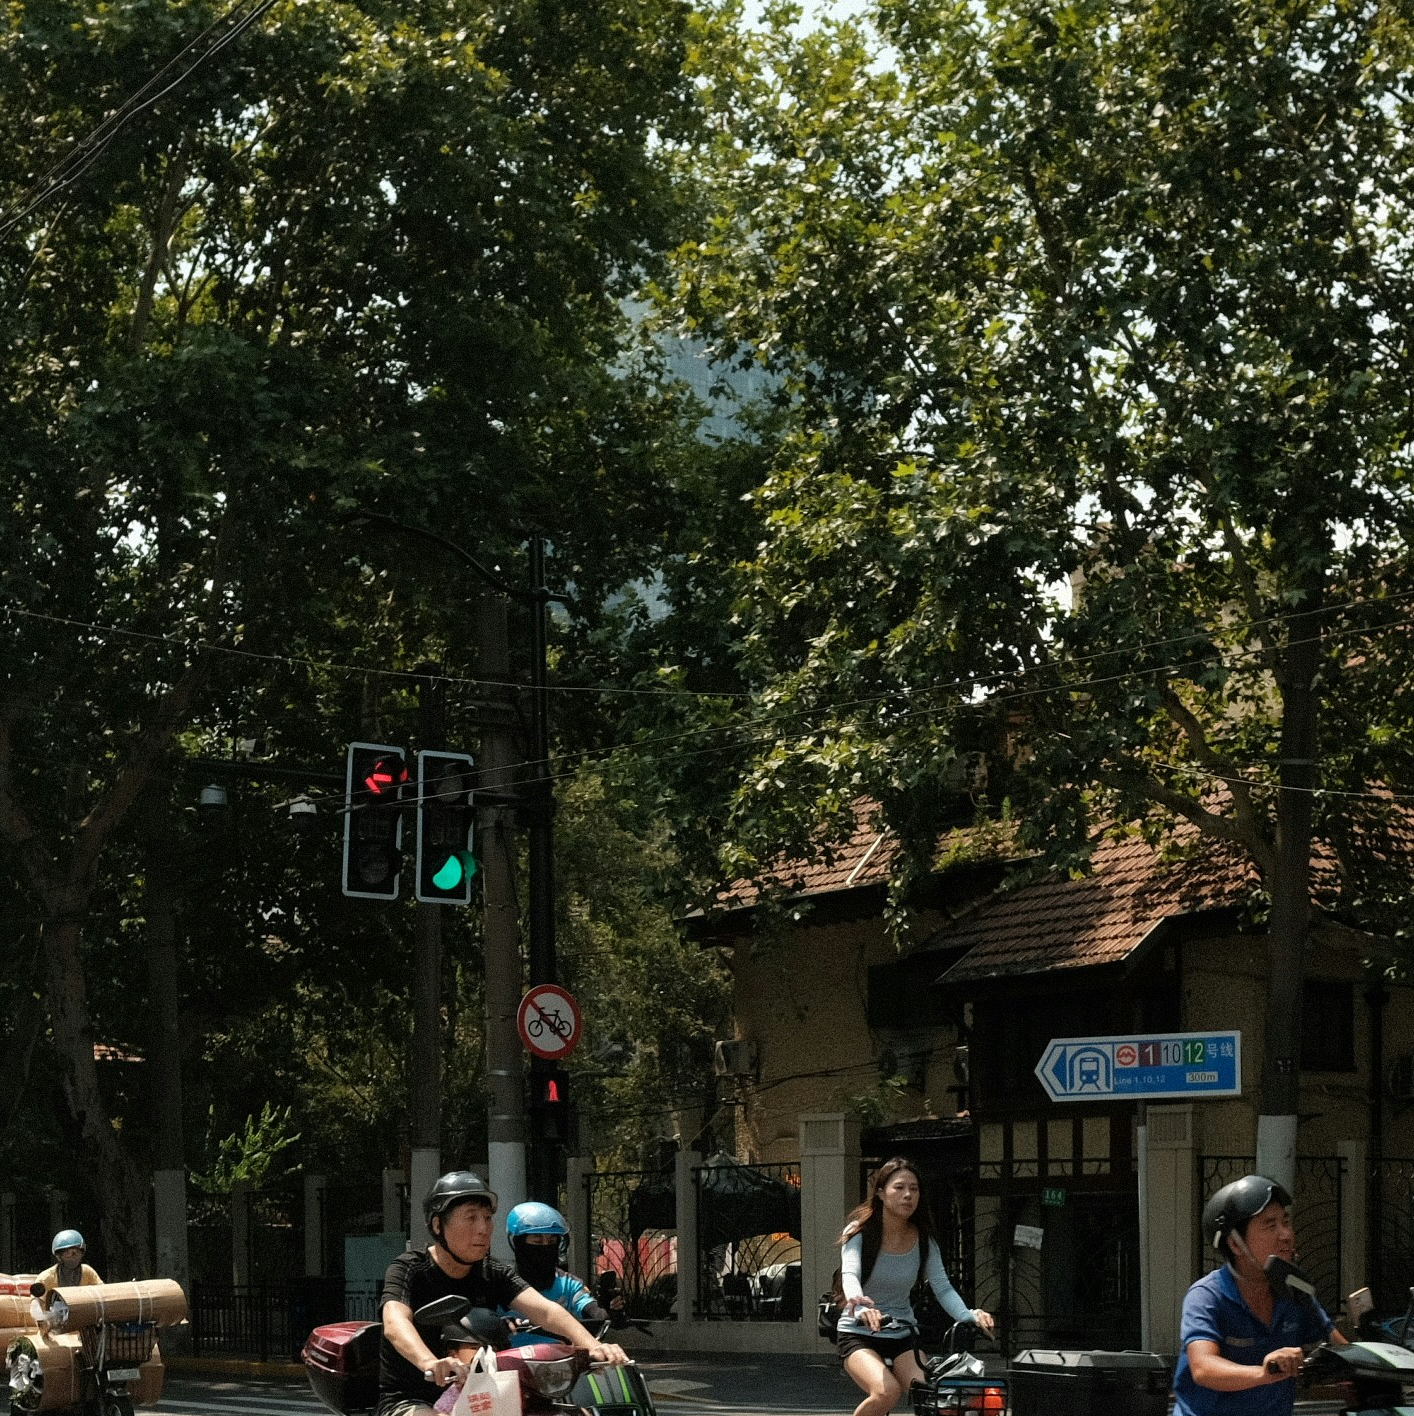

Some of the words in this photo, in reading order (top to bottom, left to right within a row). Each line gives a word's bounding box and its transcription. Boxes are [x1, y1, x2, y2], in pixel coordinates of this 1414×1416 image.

[1144, 1045, 1154, 1065] 1
[1162, 1043, 1181, 1064] 10
[1185, 1042, 1204, 1063] 12
[1206, 1042, 1234, 1059] 号线
[1113, 1076, 1132, 1085] Line
[1188, 1072, 1216, 1082] 300m
